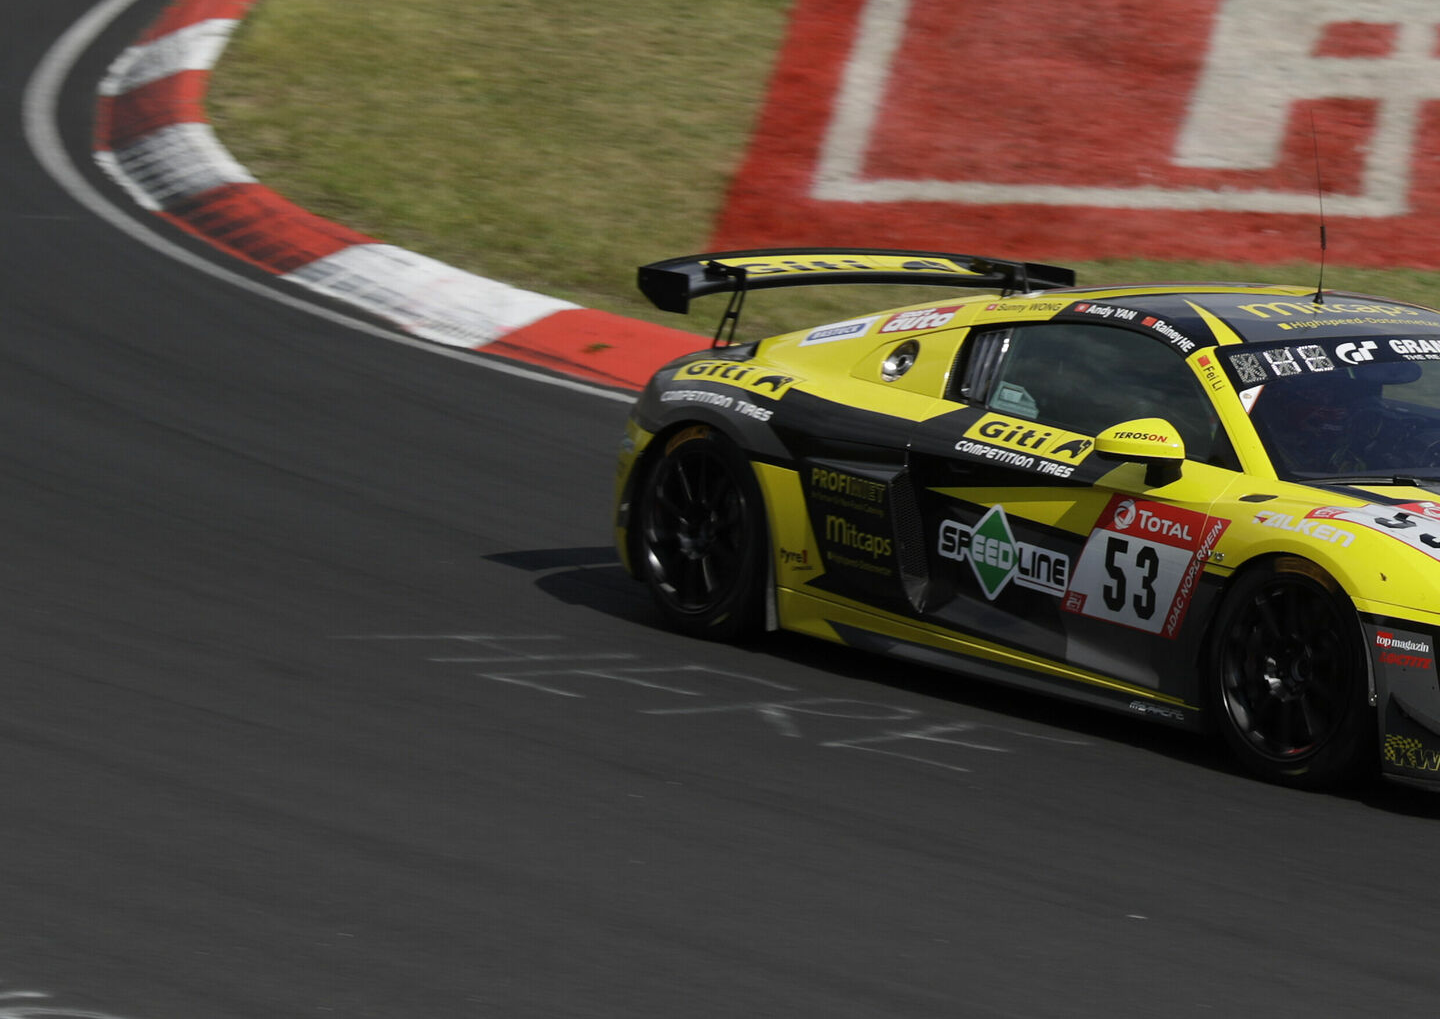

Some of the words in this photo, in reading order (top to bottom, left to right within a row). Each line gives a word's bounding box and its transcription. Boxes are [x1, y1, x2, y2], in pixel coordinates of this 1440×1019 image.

[1030, 301, 1062, 312] WONG
[1086, 304, 1113, 318] Andy
[1115, 306, 1137, 321] YAN
[881, 312, 955, 332] auto
[686, 362, 755, 380] Giti
[734, 401, 774, 421] TIRES
[979, 421, 1052, 449] Giti
[1113, 432, 1168, 443] TEROSON
[954, 440, 1034, 468] COMPETITION
[1038, 460, 1075, 478] TIRES
[1139, 509, 1192, 541] TOTAL
[1252, 510, 1356, 547] FALKEN
[941, 526, 1067, 588] SPEEDLINE
[1103, 537, 1160, 620] 53
[1167, 597, 1184, 636] ADAC
[1376, 635, 1391, 647] top
[1391, 639, 1429, 653] magazin
